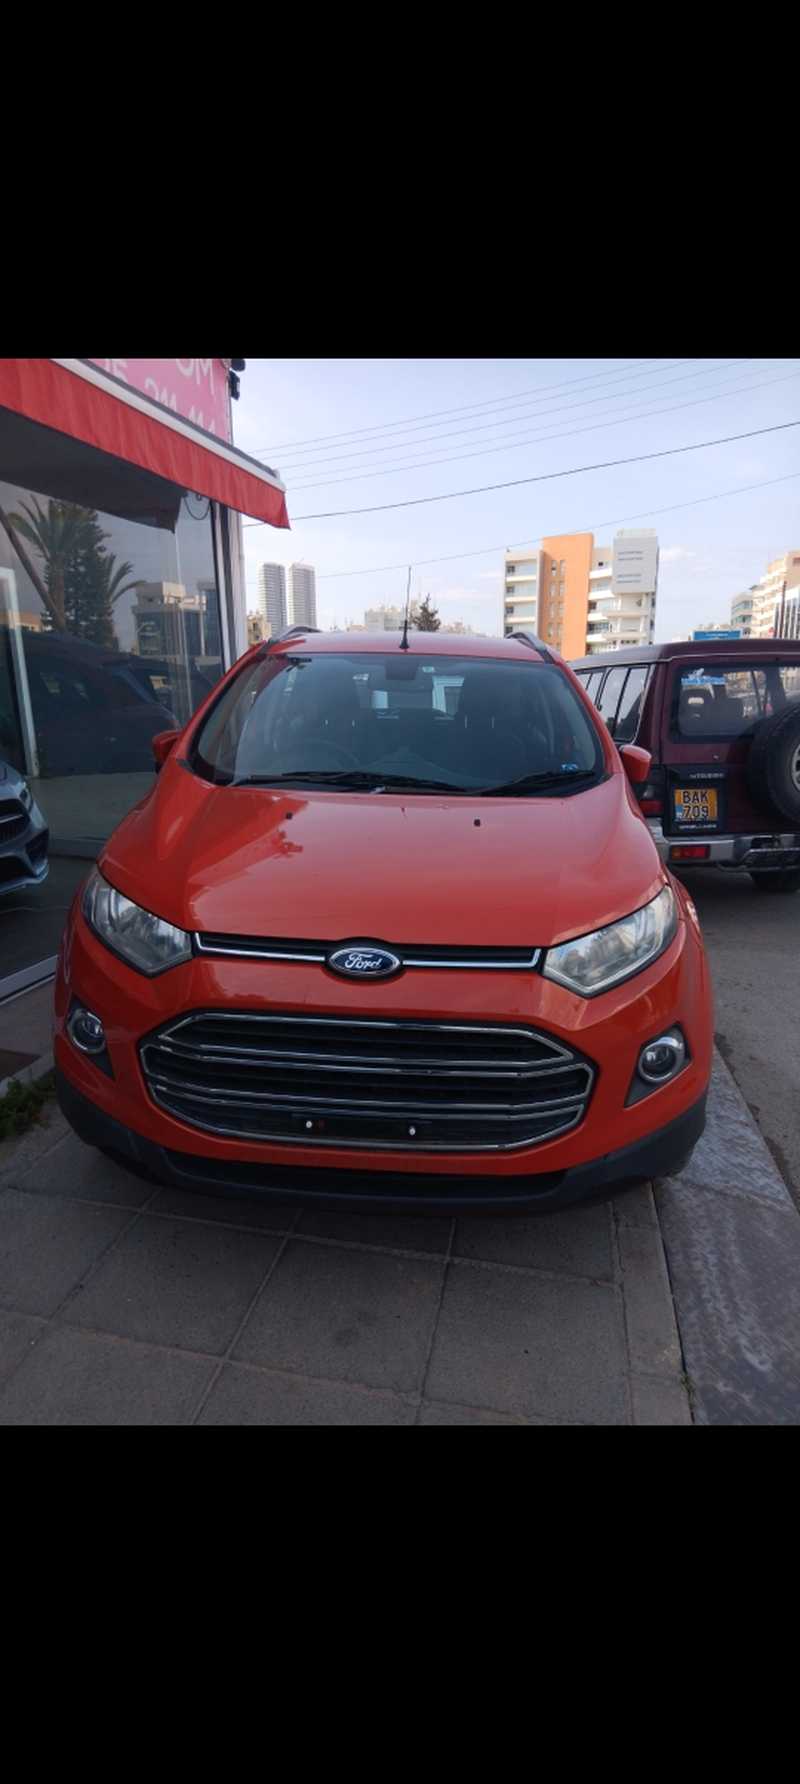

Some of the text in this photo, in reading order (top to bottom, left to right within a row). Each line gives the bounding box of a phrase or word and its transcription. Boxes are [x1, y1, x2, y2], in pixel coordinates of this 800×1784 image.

[682, 790, 709, 804] BAK
[683, 805, 709, 818] 709
[344, 952, 383, 970] Ford
